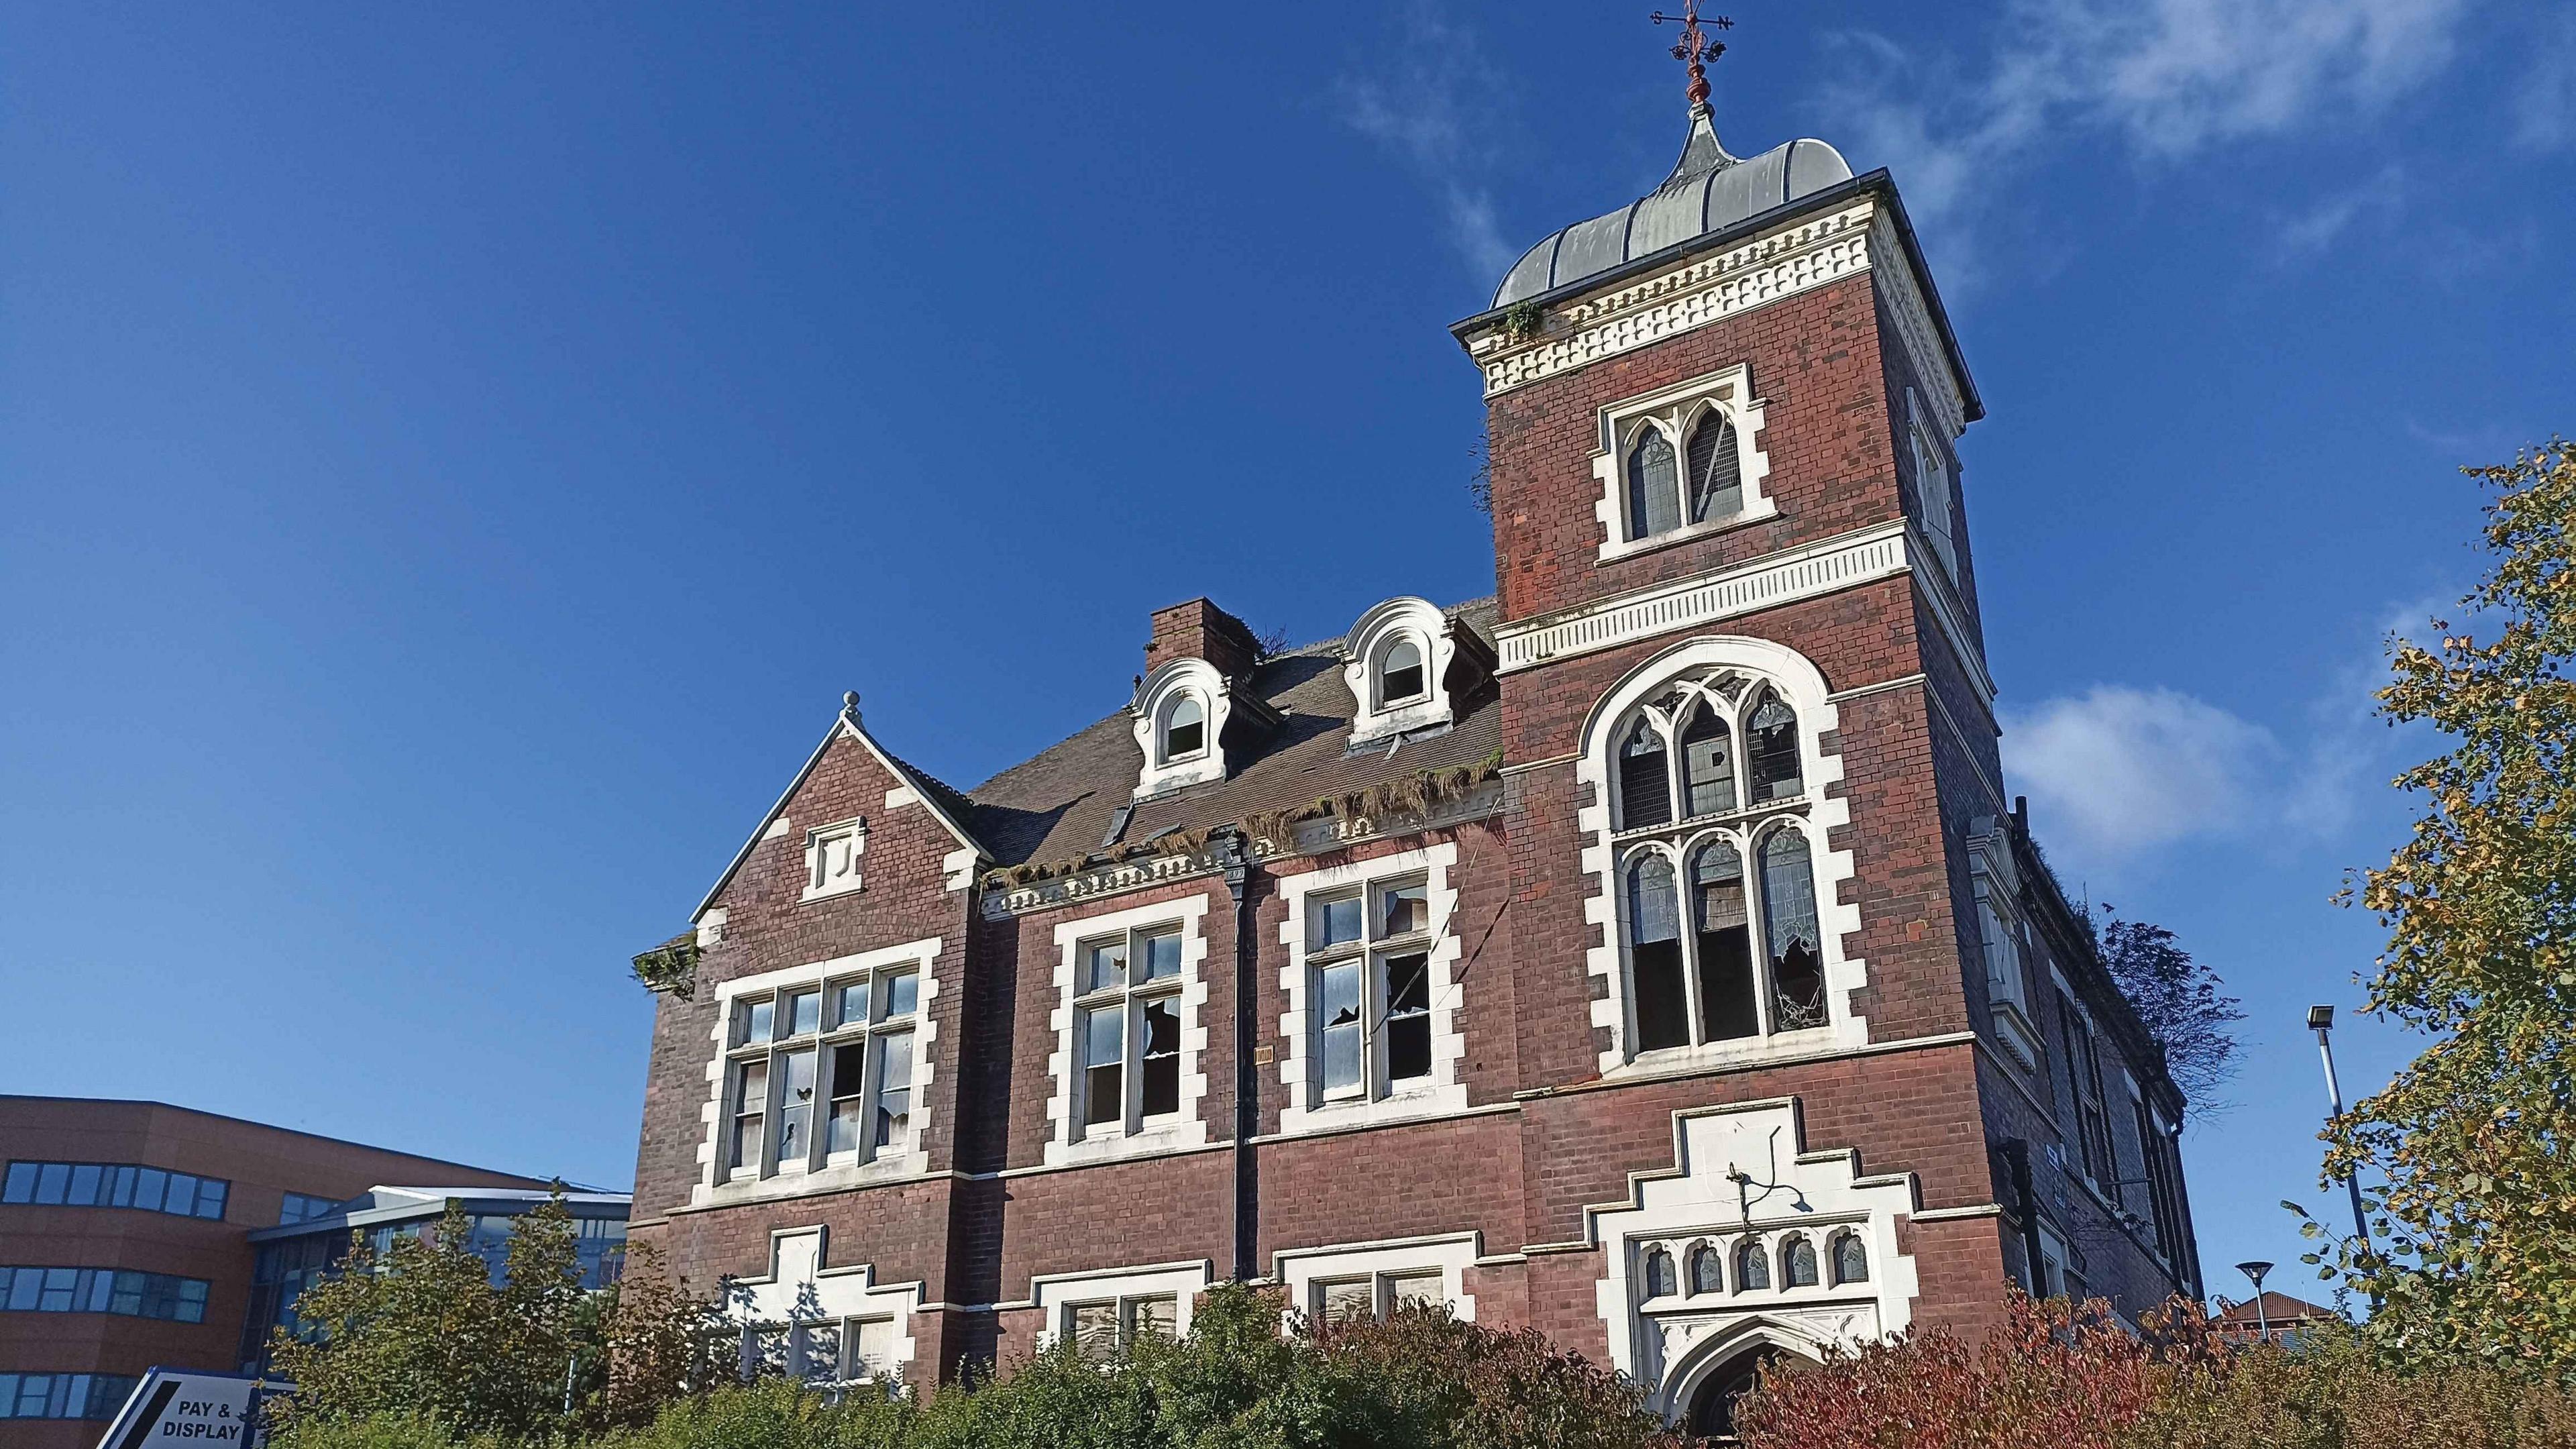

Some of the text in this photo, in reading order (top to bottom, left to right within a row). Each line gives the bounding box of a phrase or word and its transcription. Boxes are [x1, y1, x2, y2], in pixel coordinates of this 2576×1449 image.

[1653, 11, 1662, 25] S
[1718, 15, 1729, 30] N
[178, 1401, 230, 1418] PAY &
[163, 1421, 240, 1440] DISPLAY
